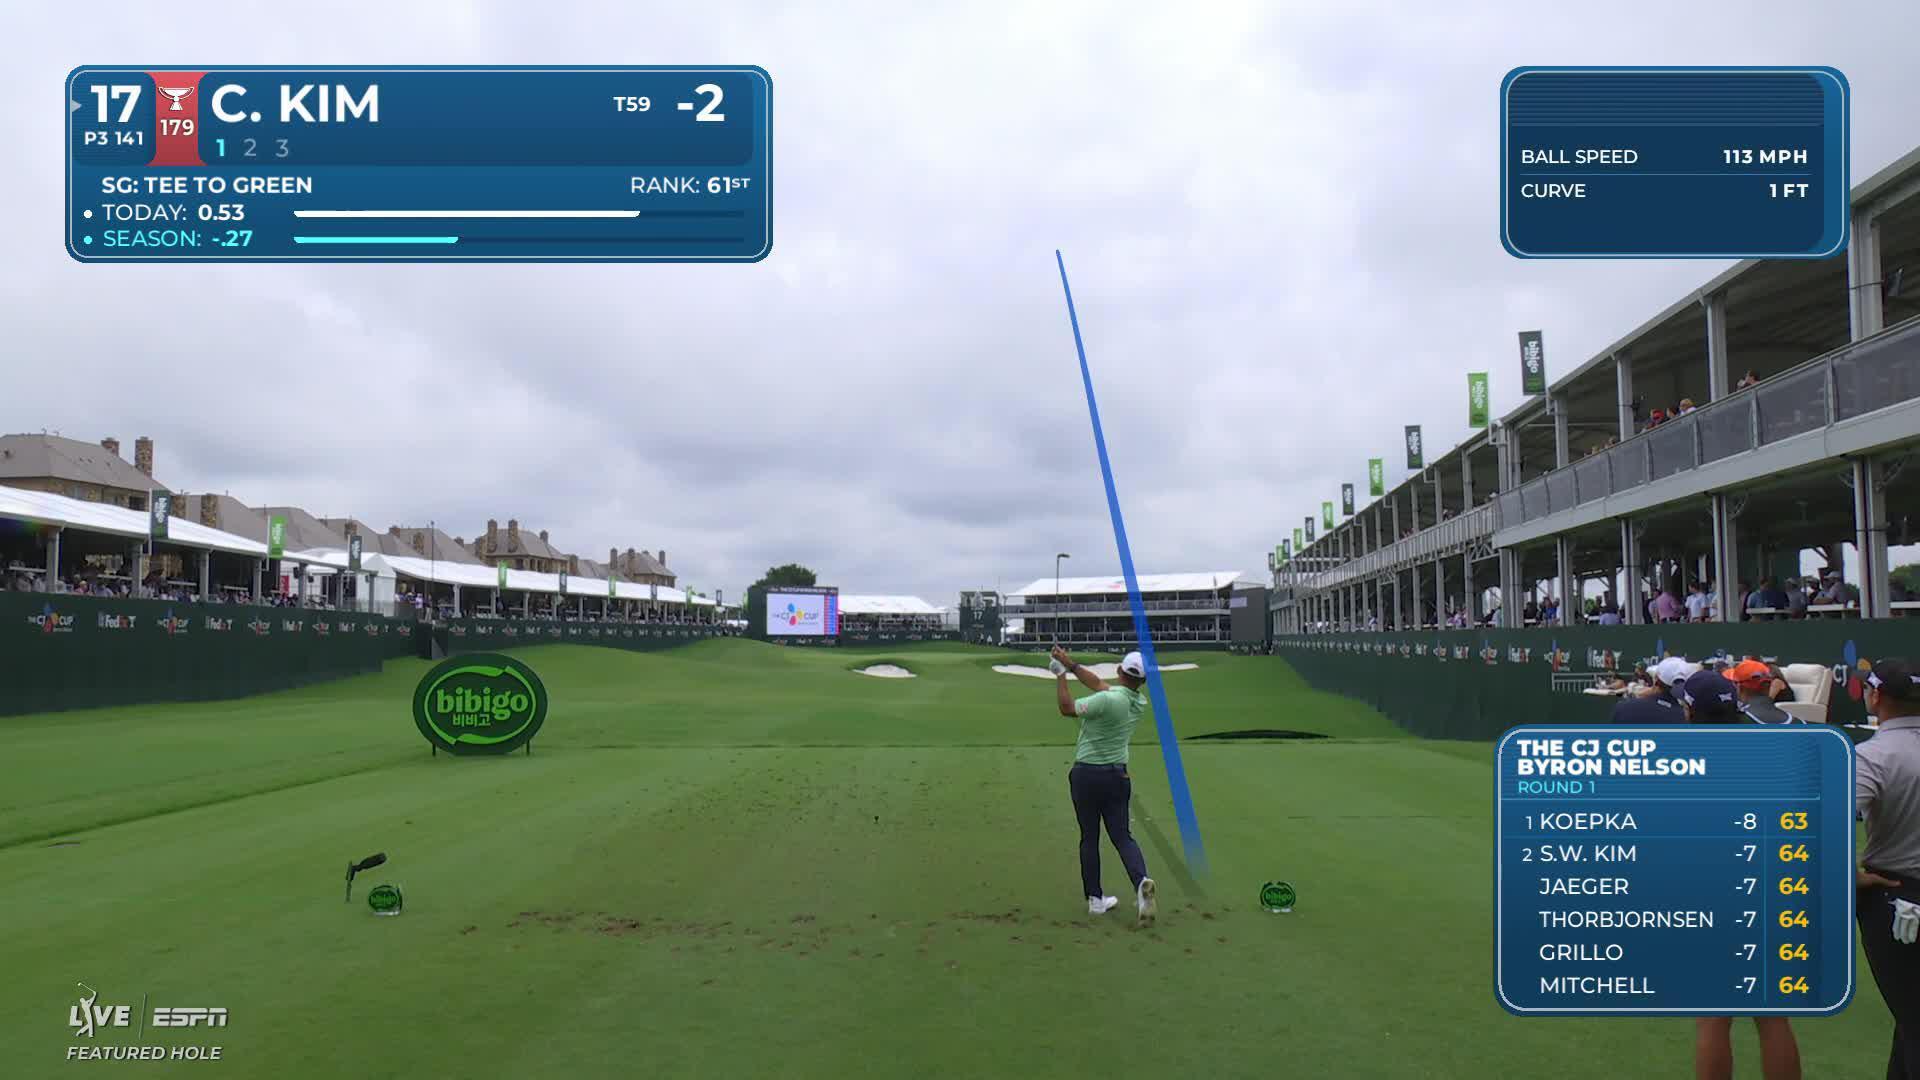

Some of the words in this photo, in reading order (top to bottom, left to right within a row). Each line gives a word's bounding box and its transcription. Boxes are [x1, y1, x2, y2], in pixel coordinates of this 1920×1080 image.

[1527, 340, 1540, 373] bibigo
[59, 616, 74, 626] CUP
[1832, 664, 1849, 686] CJ
[437, 686, 529, 721] bibigo
[452, 713, 491, 727] 비비고
